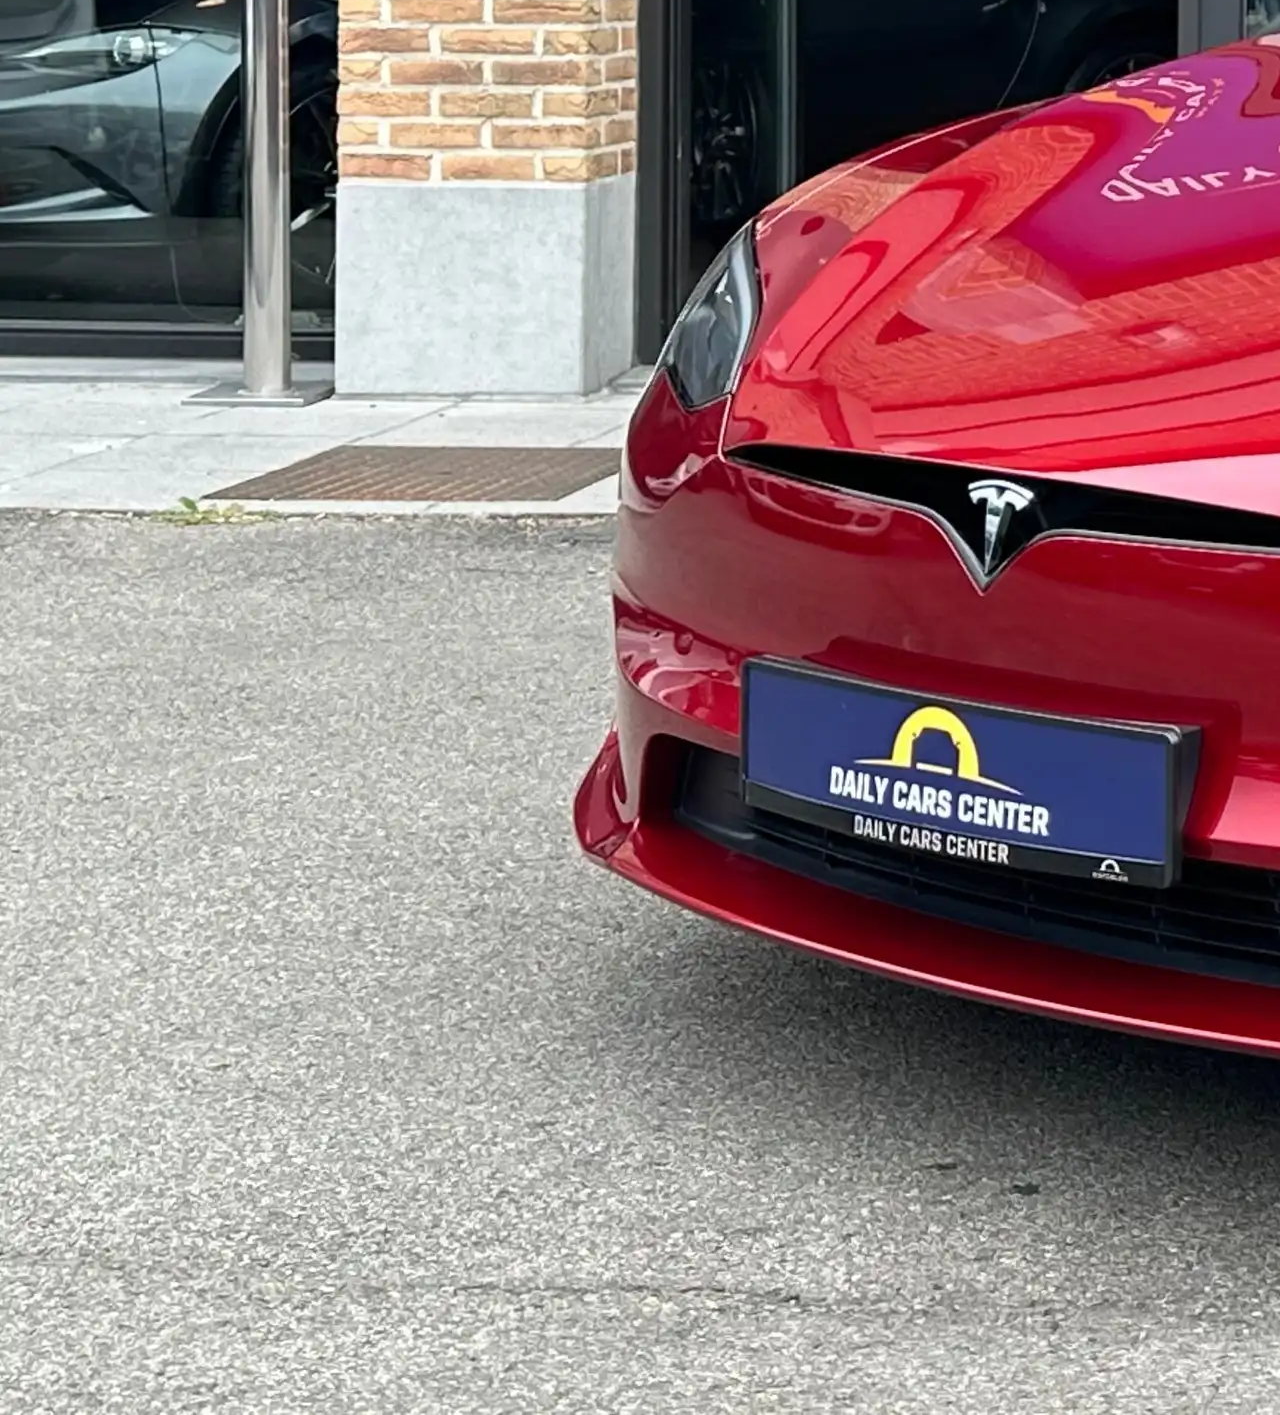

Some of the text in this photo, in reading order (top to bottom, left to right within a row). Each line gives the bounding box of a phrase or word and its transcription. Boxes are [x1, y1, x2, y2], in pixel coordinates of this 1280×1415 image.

[829, 765, 1050, 837] DAILY CARS CENTER
[853, 814, 1010, 866] DAILY CARS CENTER
